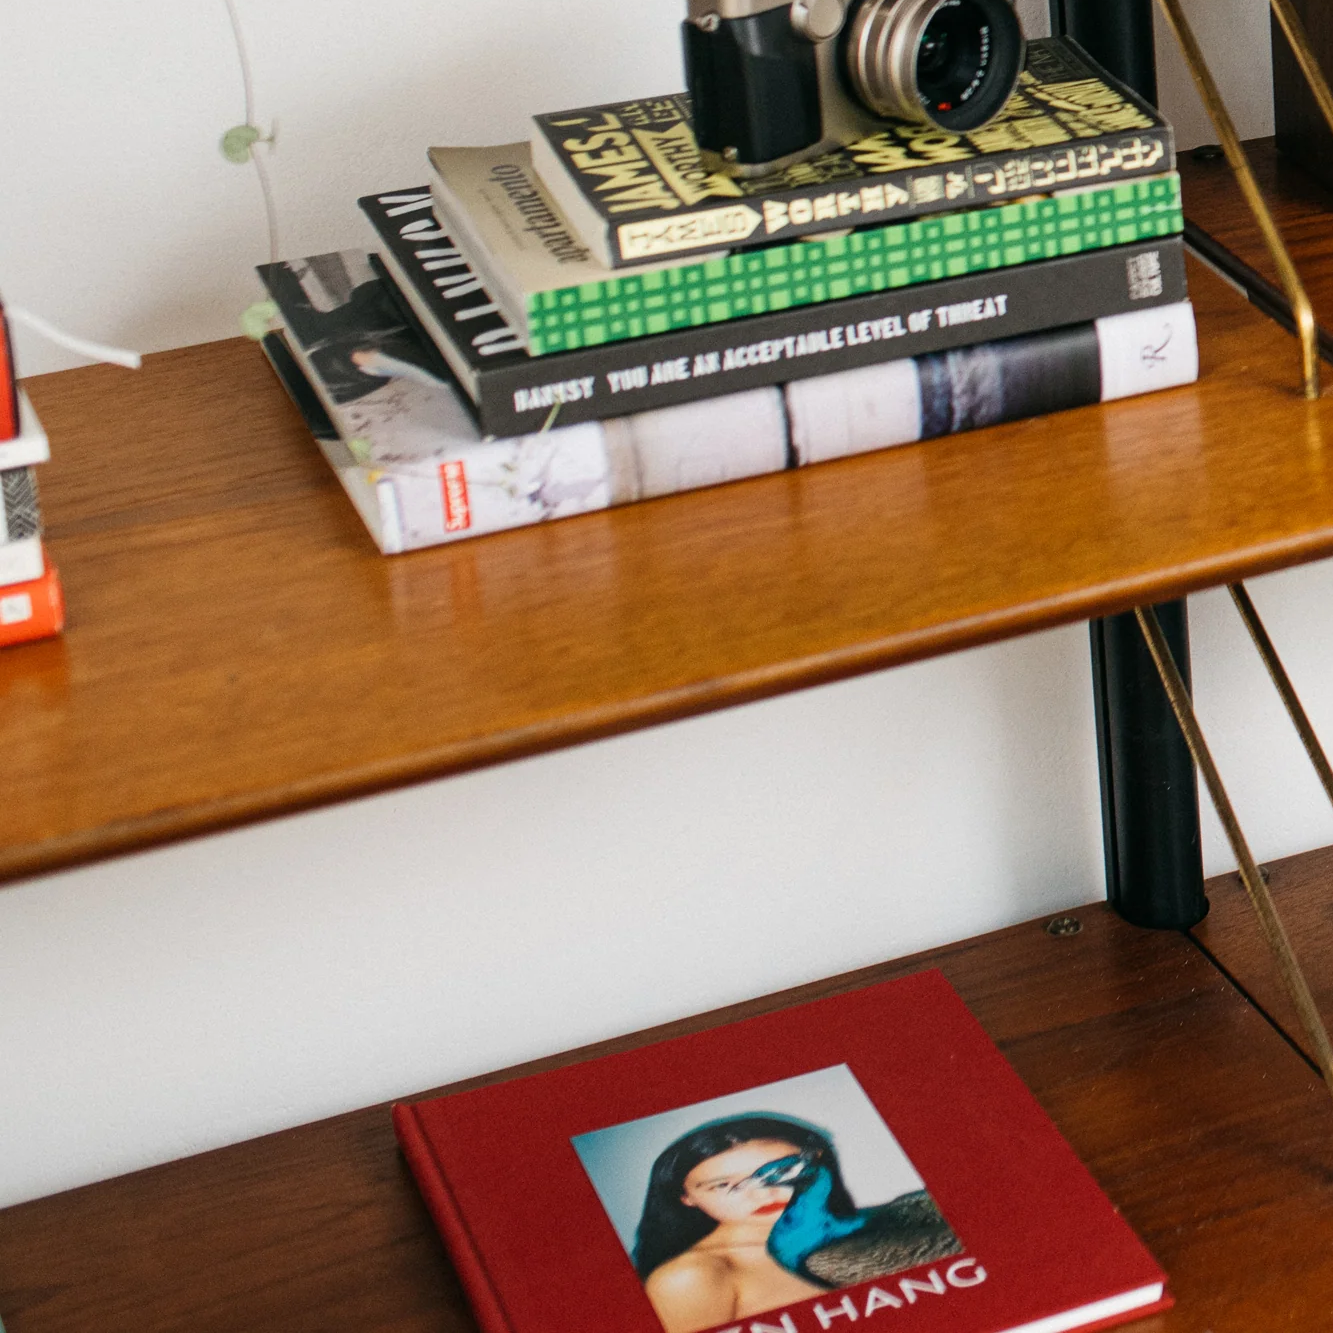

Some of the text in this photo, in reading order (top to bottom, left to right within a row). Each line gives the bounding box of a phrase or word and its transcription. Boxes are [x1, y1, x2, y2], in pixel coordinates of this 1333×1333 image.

[489, 164, 590, 263] apartamento
[563, 130, 681, 214] JAMES
[763, 182, 909, 234] WORTHY
[513, 295, 1008, 412] BANKSY YOU ARE AN ACCEPTABLE LEVEL OF THREAT
[812, 1258, 988, 1331] HANG
